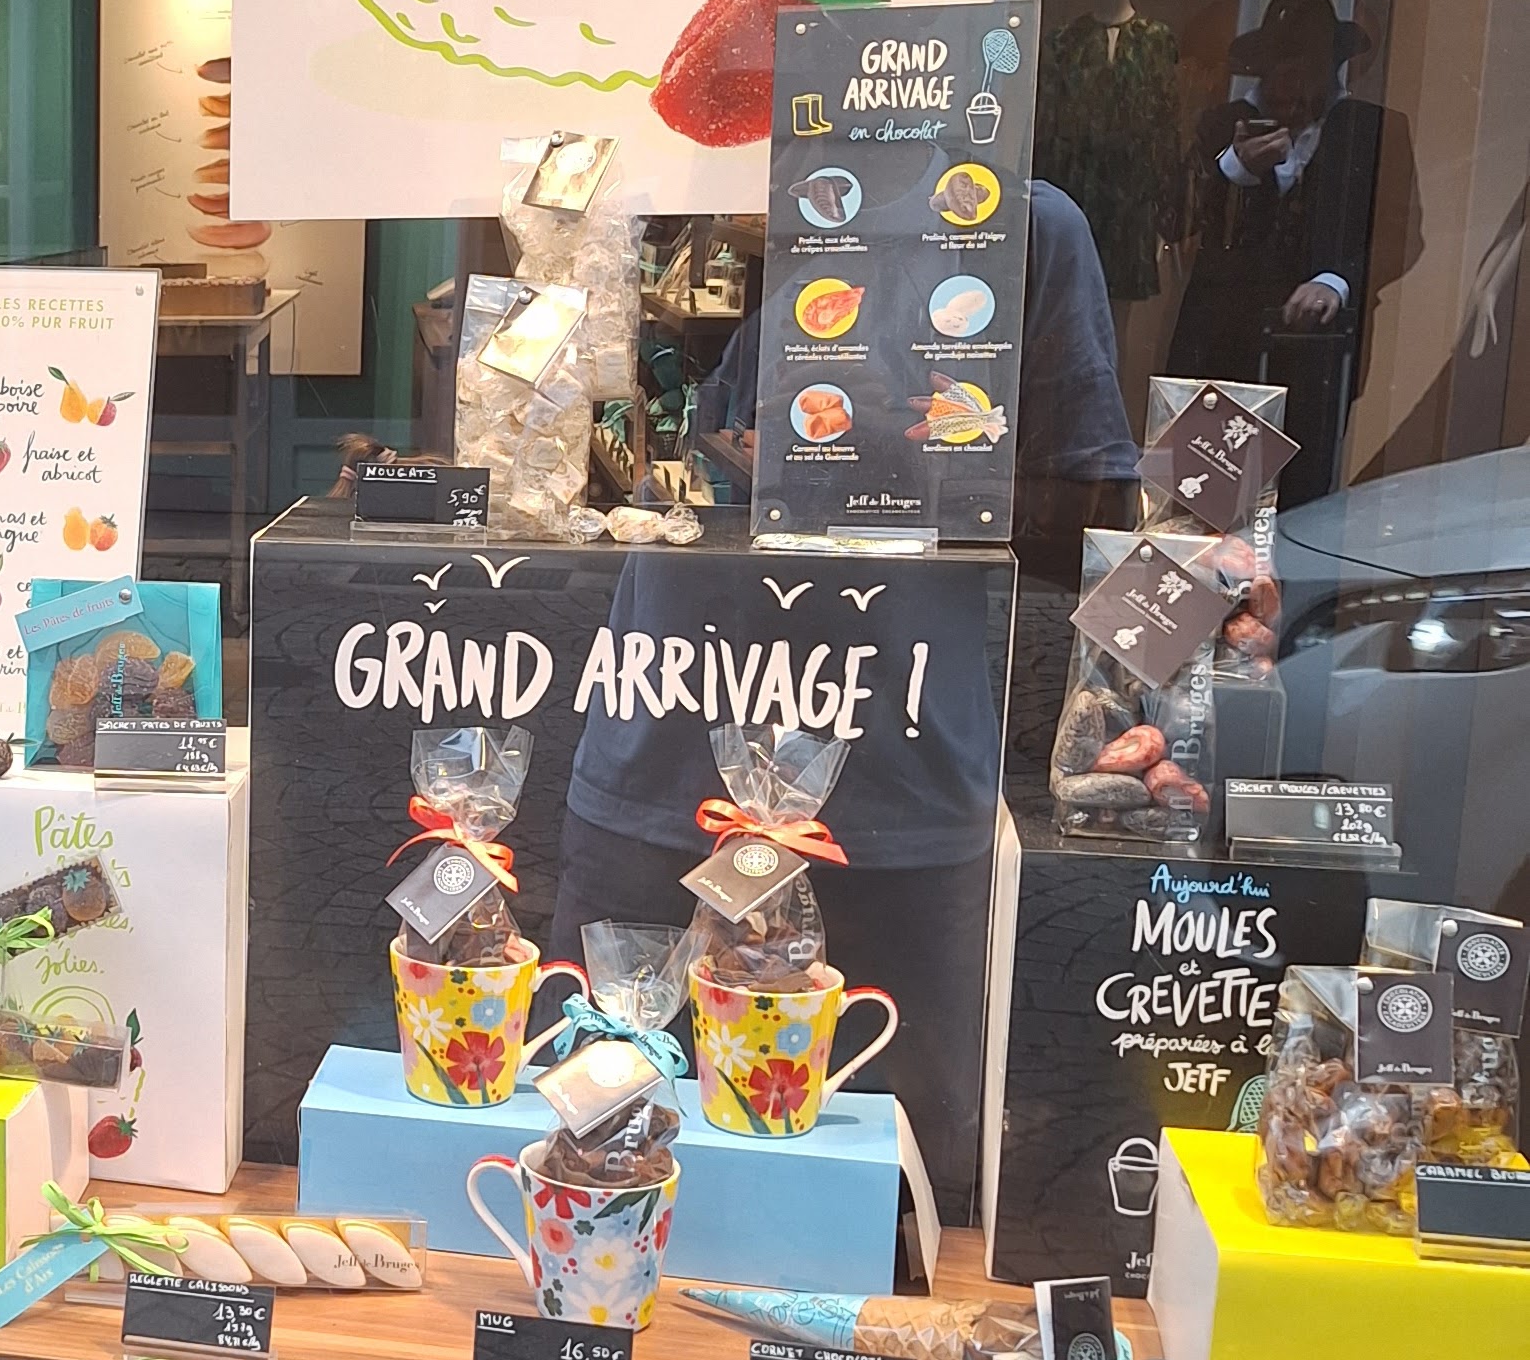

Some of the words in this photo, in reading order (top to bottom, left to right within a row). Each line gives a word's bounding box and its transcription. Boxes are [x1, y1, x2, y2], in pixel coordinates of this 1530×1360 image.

[861, 39, 948, 77] GRAND
[848, 126, 871, 141] en
[874, 119, 948, 143] chocolat
[27, 298, 105, 312] RECETTES
[31, 315, 62, 329] PUR
[68, 316, 115, 330] FRUIT
[22, 429, 73, 474] fraise
[77, 446, 97, 462] et
[1190, 435, 1210, 452] Jeff
[1214, 449, 1243, 476] Bruges
[41, 462, 103, 484] abricot
[365, 466, 437, 479] NOUGATS
[846, 493, 870, 508] Jeff
[879, 493, 922, 509] Bruges
[30, 511, 48, 526] et
[23, 622, 42, 637] Les
[42, 613, 70, 631] Pâtes
[72, 606, 85, 619] de
[86, 597, 115, 614] fruits
[7, 644, 24, 659] et
[334, 621, 555, 724] GRAND
[904, 641, 929, 739] !
[1171, 663, 1213, 761] Bruges
[173, 720, 187, 729] DE
[34, 805, 114, 857] Pâtes
[1150, 863, 1270, 903] Aujourd'hui
[1131, 899, 1278, 959] MOULES
[35, 947, 106, 985] jolies.
[1178, 958, 1202, 977] et
[1111, 1032, 1226, 1059] préparées
[1230, 1034, 1249, 1054] à
[1163, 1061, 1232, 1097] JEFF
[1415, 1164, 1483, 1180] CARAMEL
[333, 1253, 358, 1270] Jeff
[372, 1251, 422, 1274] Bruges
[128, 1272, 183, 1289] REGLETTE
[212, 1301, 267, 1325] 13,30€
[478, 1311, 515, 1330] MUG
[750, 1342, 805, 1359] CORNET
